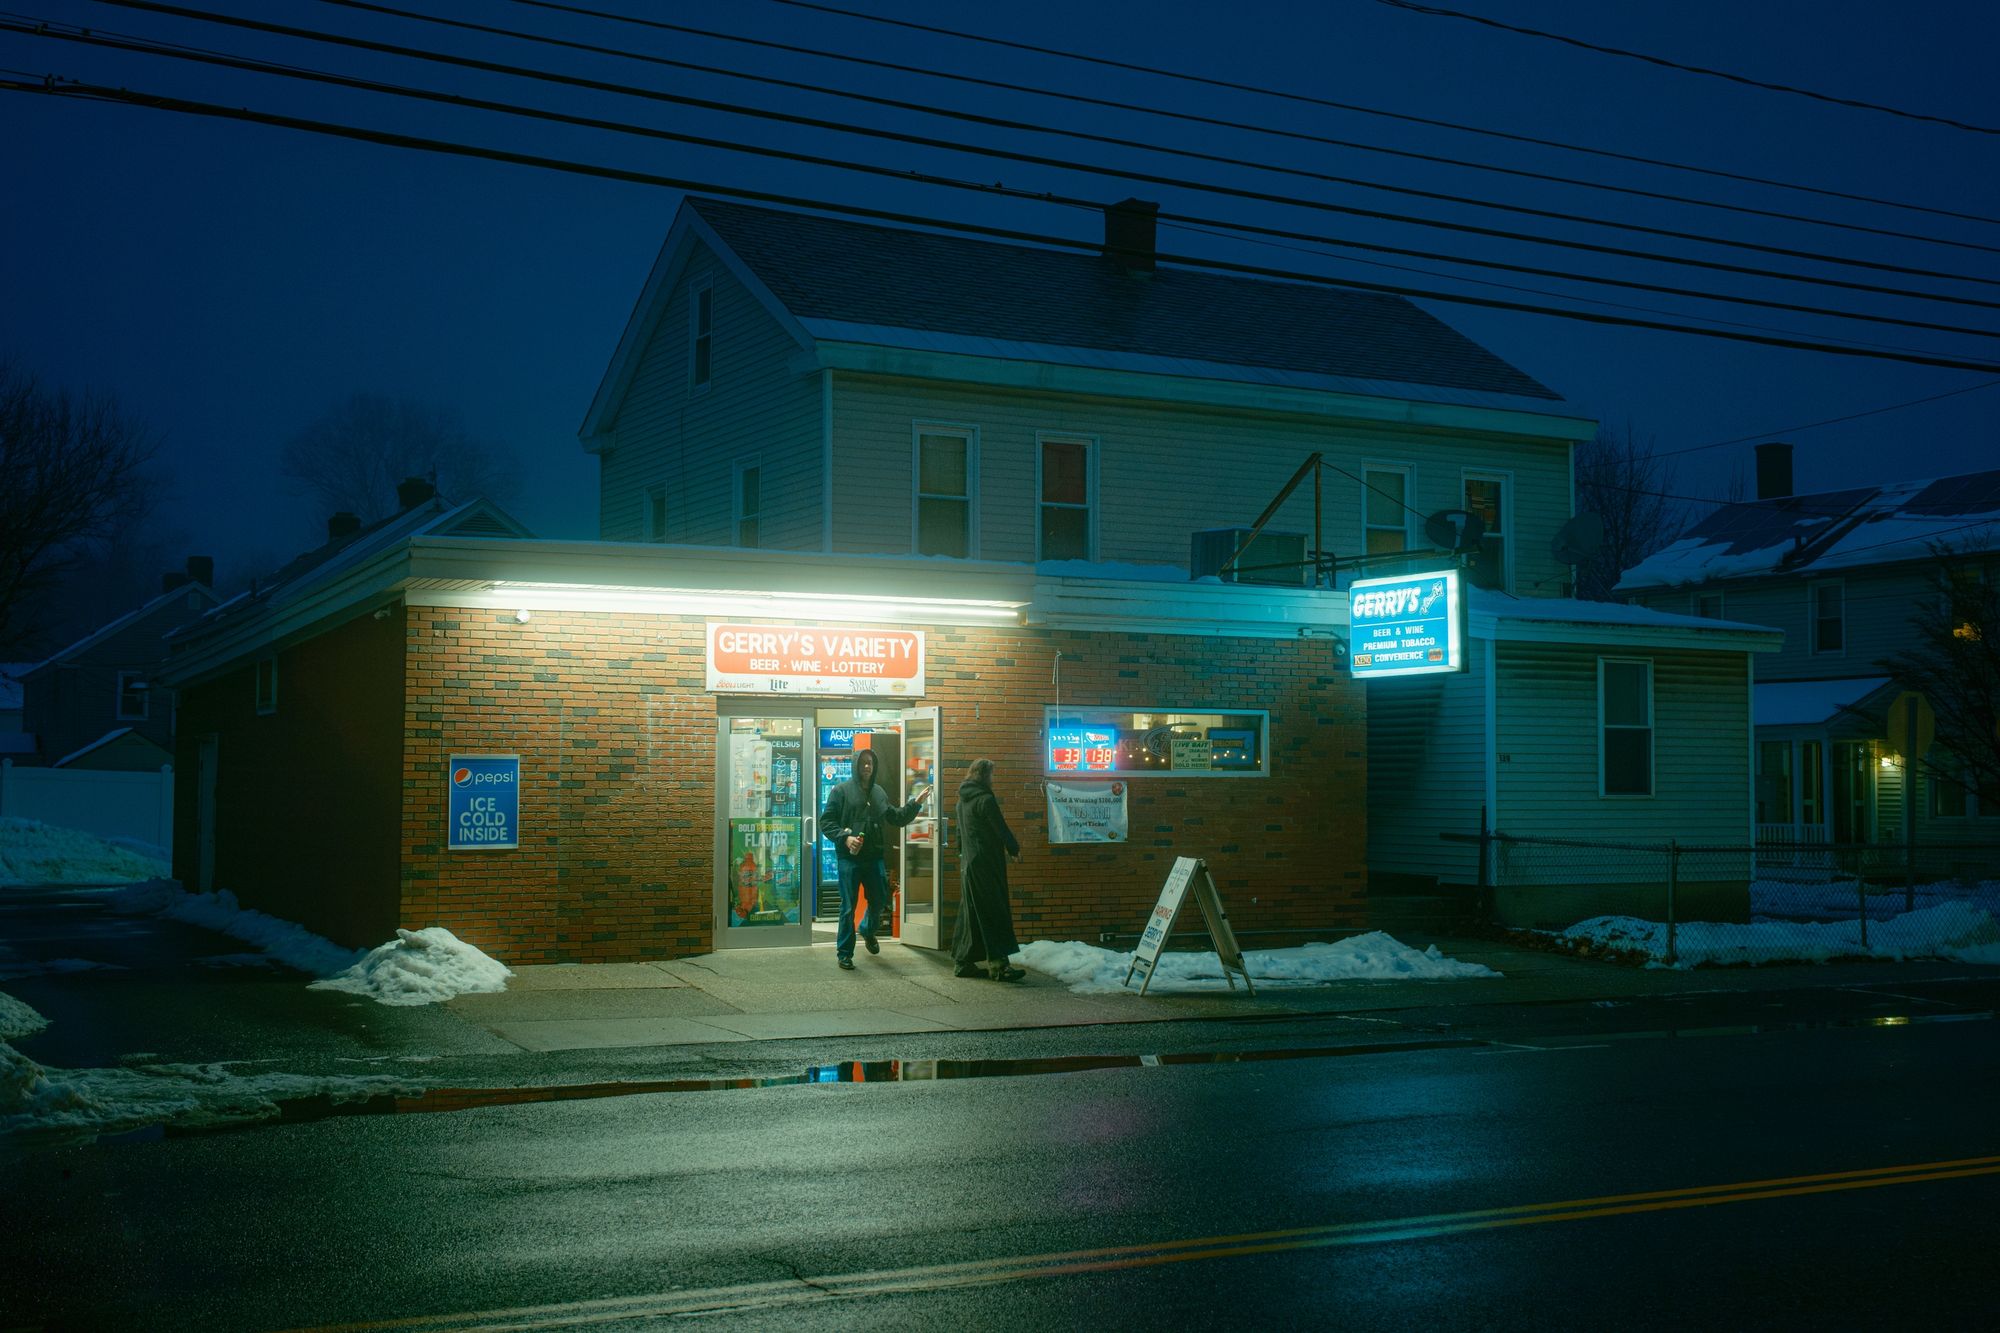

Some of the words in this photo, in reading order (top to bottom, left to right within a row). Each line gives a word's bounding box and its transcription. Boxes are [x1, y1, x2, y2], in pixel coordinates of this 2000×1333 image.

[1353, 587, 1421, 618] GERRY'S
[1373, 628, 1391, 637] BEER
[1395, 627, 1401, 636] &
[1405, 625, 1424, 634] WINE
[719, 631, 815, 656] GERRY'S
[822, 635, 913, 659] VARIETY
[1363, 641, 1397, 650] PREMIUM
[1401, 637, 1435, 648] TOBACCO
[1354, 655, 1372, 665] KENO
[1374, 651, 1424, 662] CONVENIENCE
[750, 659, 780, 671] BEER
[791, 660, 821, 672] WINE
[831, 662, 885, 674] LOTTERY
[770, 678, 789, 691] Lite
[849, 678, 878, 688] SAMUEL
[851, 686, 876, 694] ADAMS
[1064, 749, 1080, 762] 33
[475, 771, 513, 785] pepsi
[776, 753, 786, 801] ENERGY
[470, 797, 496, 811] ICE
[460, 812, 505, 826] COLD
[460, 827, 508, 841] INSIDE
[744, 833, 788, 848] FLAVOR
